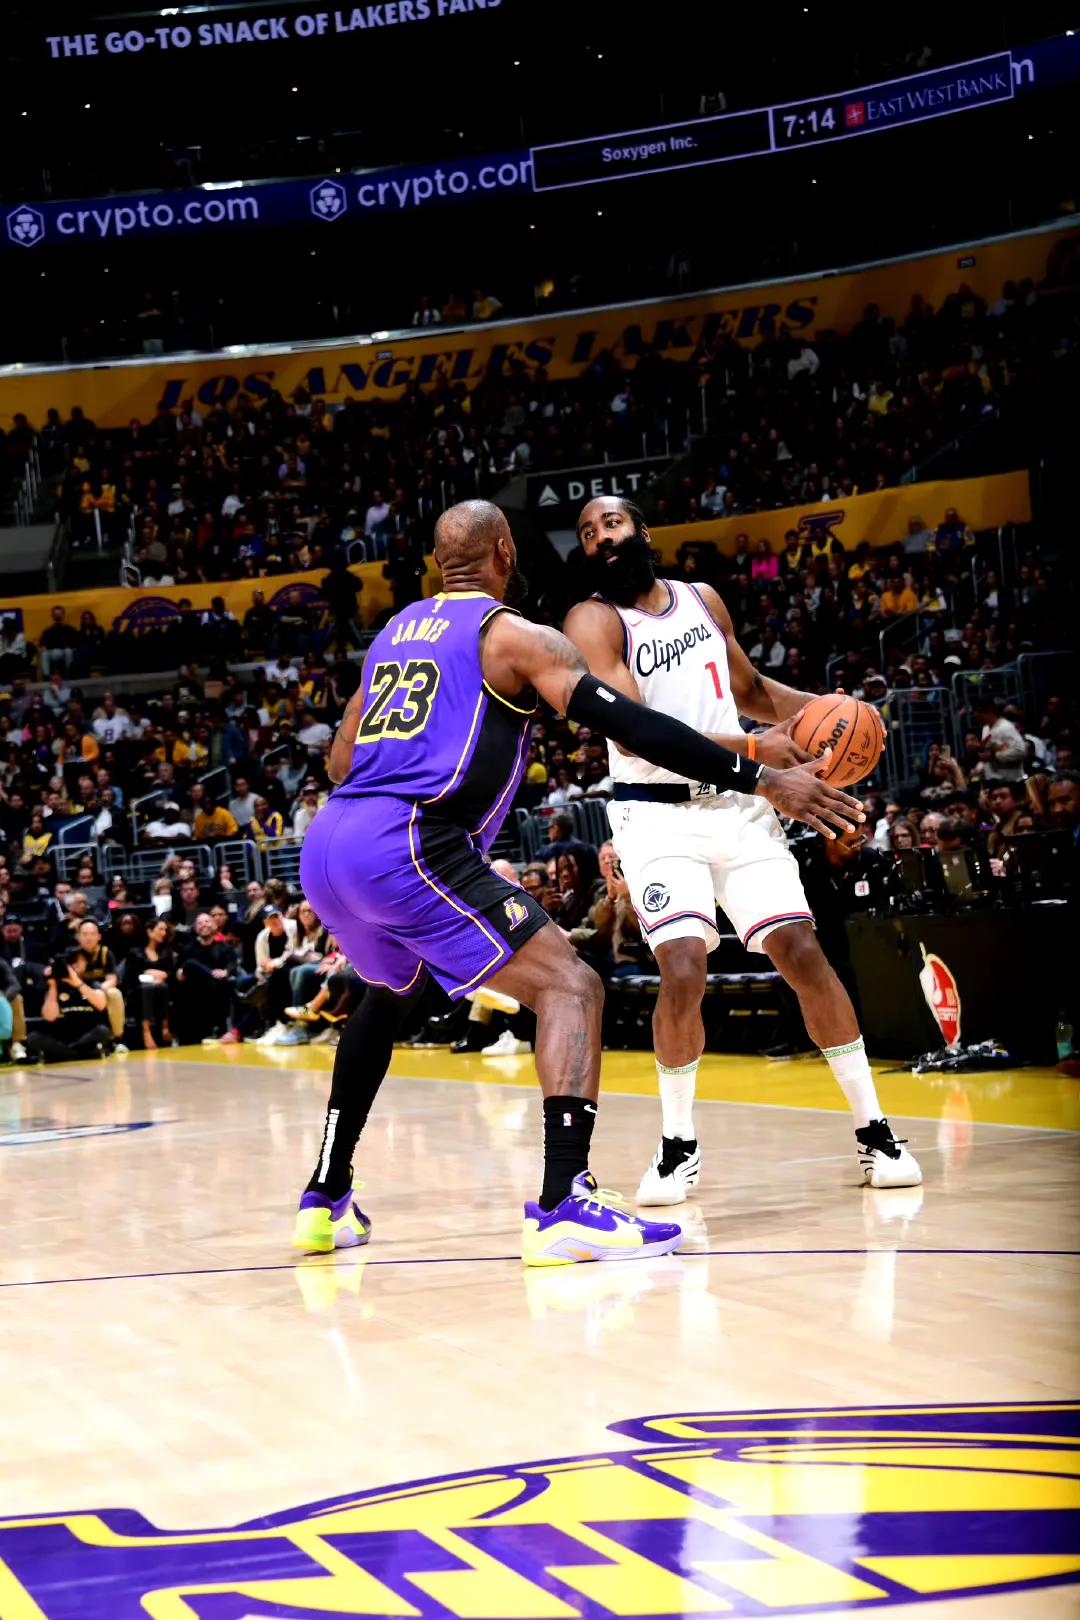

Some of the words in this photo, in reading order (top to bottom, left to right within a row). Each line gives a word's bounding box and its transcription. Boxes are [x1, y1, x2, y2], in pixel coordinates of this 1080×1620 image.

[46, 34, 99, 58] THE
[105, 26, 192, 53] GO-TO
[198, 17, 289, 46] SNACK
[294, 13, 328, 37] OF
[334, 0, 431, 32] LAKERS
[783, 107, 835, 138] 7:14
[602, 139, 666, 162] Soxygen
[670, 136, 697, 150] Inc.
[56, 197, 259, 237] crypto.com
[158, 370, 275, 409] LOS
[291, 337, 556, 397] ANGELES
[571, 296, 818, 362] LAKERS
[567, 471, 656, 500] DELT
[391, 617, 450, 646] JAMES
[636, 623, 712, 677] Clippers
[705, 661, 724, 700] 1
[355, 659, 440, 744] 23
